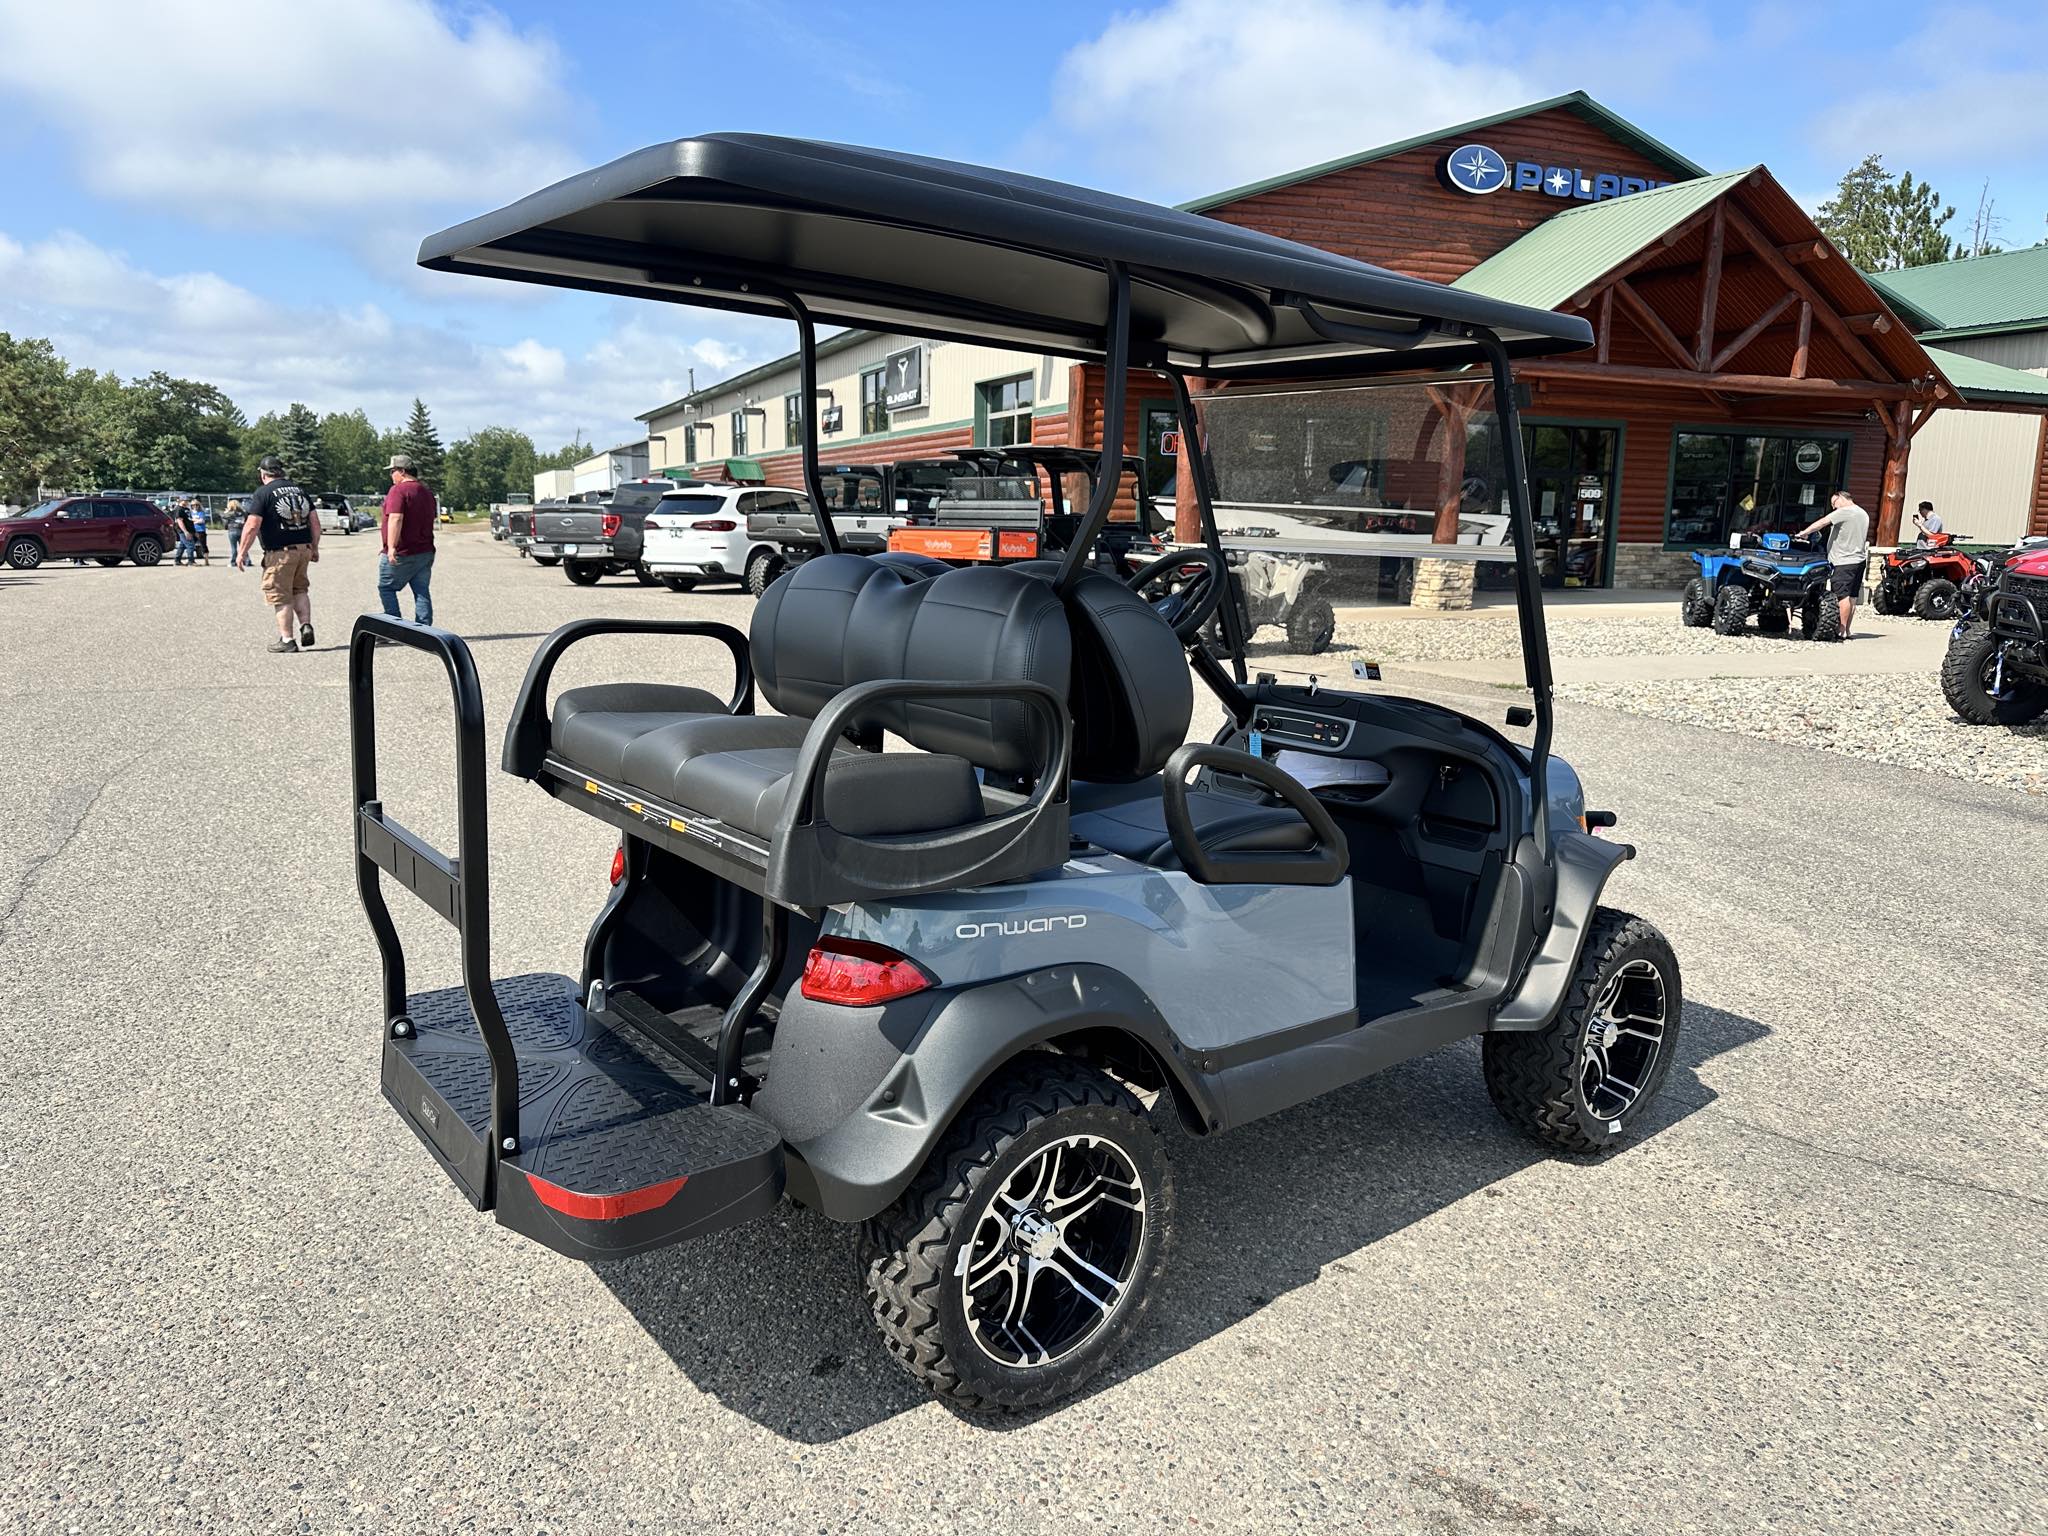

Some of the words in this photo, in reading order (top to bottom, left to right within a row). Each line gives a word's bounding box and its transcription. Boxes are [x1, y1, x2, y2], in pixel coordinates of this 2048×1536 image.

[1515, 161, 1672, 200] POLAR
[1580, 488, 1601, 499] 509
[1001, 543, 1027, 553] Kubota
